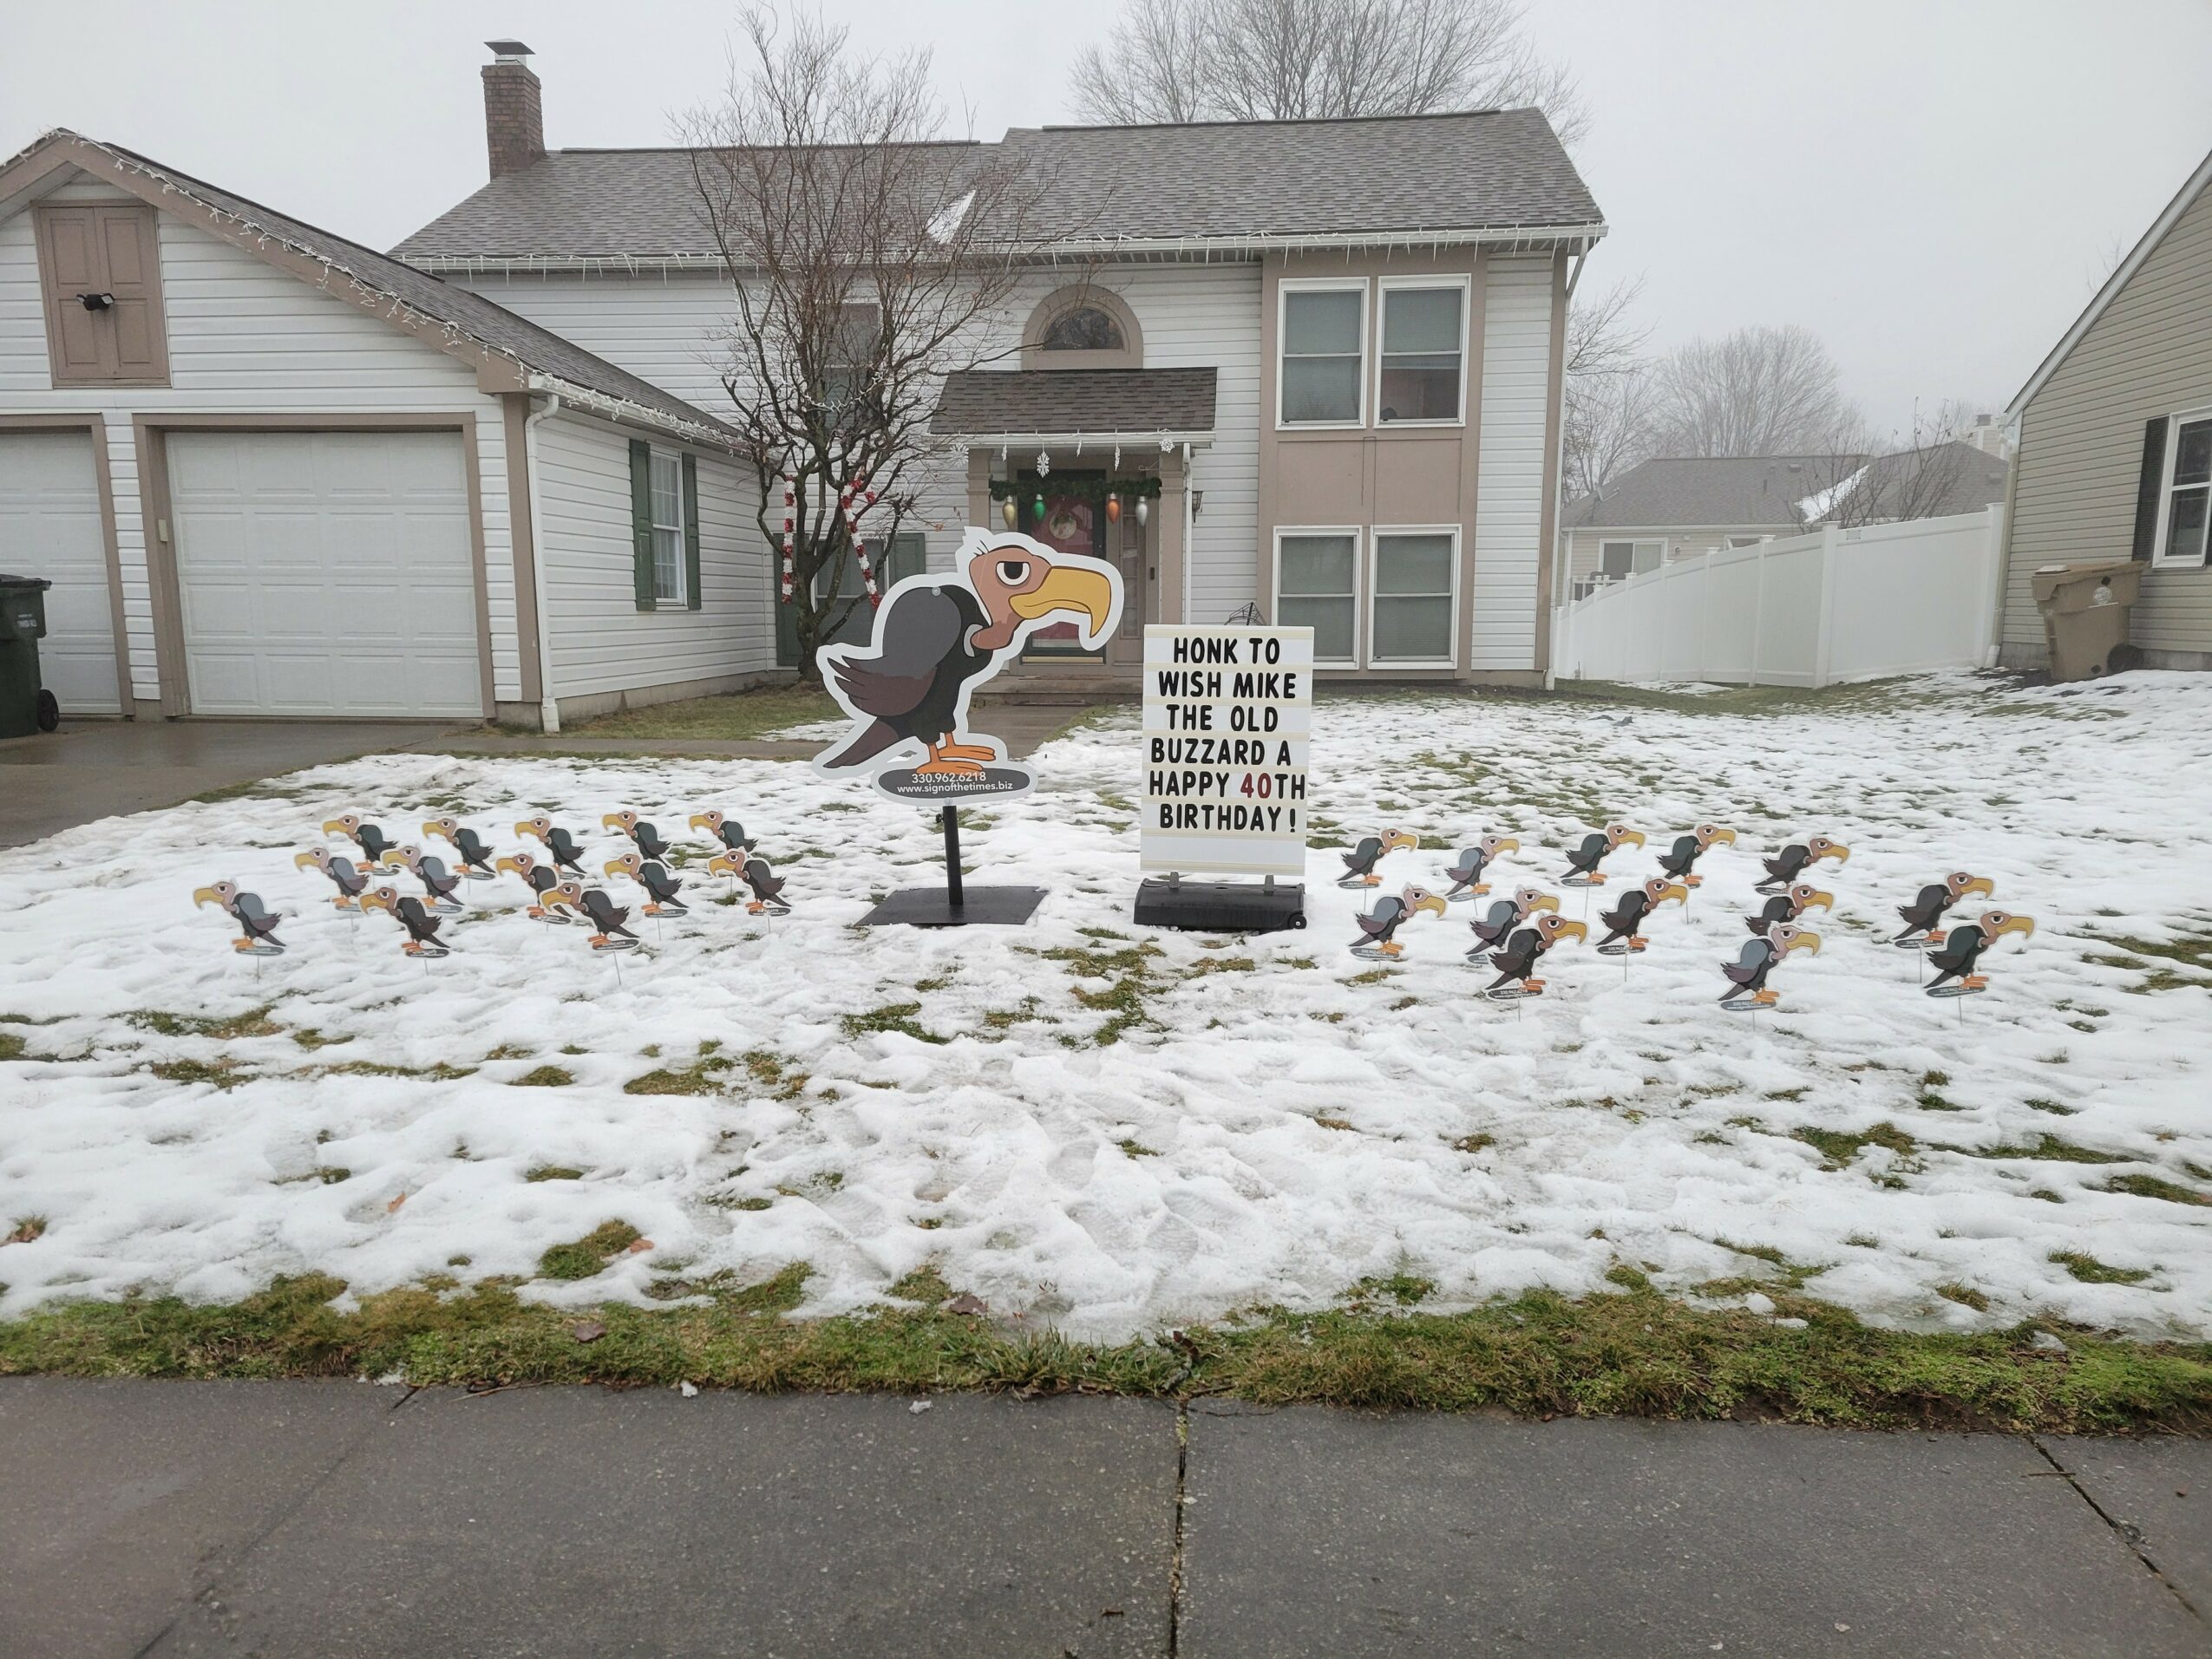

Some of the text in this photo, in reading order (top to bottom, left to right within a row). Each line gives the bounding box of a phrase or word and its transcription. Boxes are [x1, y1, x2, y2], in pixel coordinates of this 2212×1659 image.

[1174, 637, 1279, 664] HONK TO
[1159, 671, 1296, 698] WISH MIKE
[1167, 704, 1278, 732] THE OLD
[1151, 738, 1291, 766] BUZZARD A
[897, 781, 1013, 794] www.signofthetimes.biz
[911, 772, 986, 784] 330.962.6218
[1150, 770, 1305, 800] HAPPY 40TH
